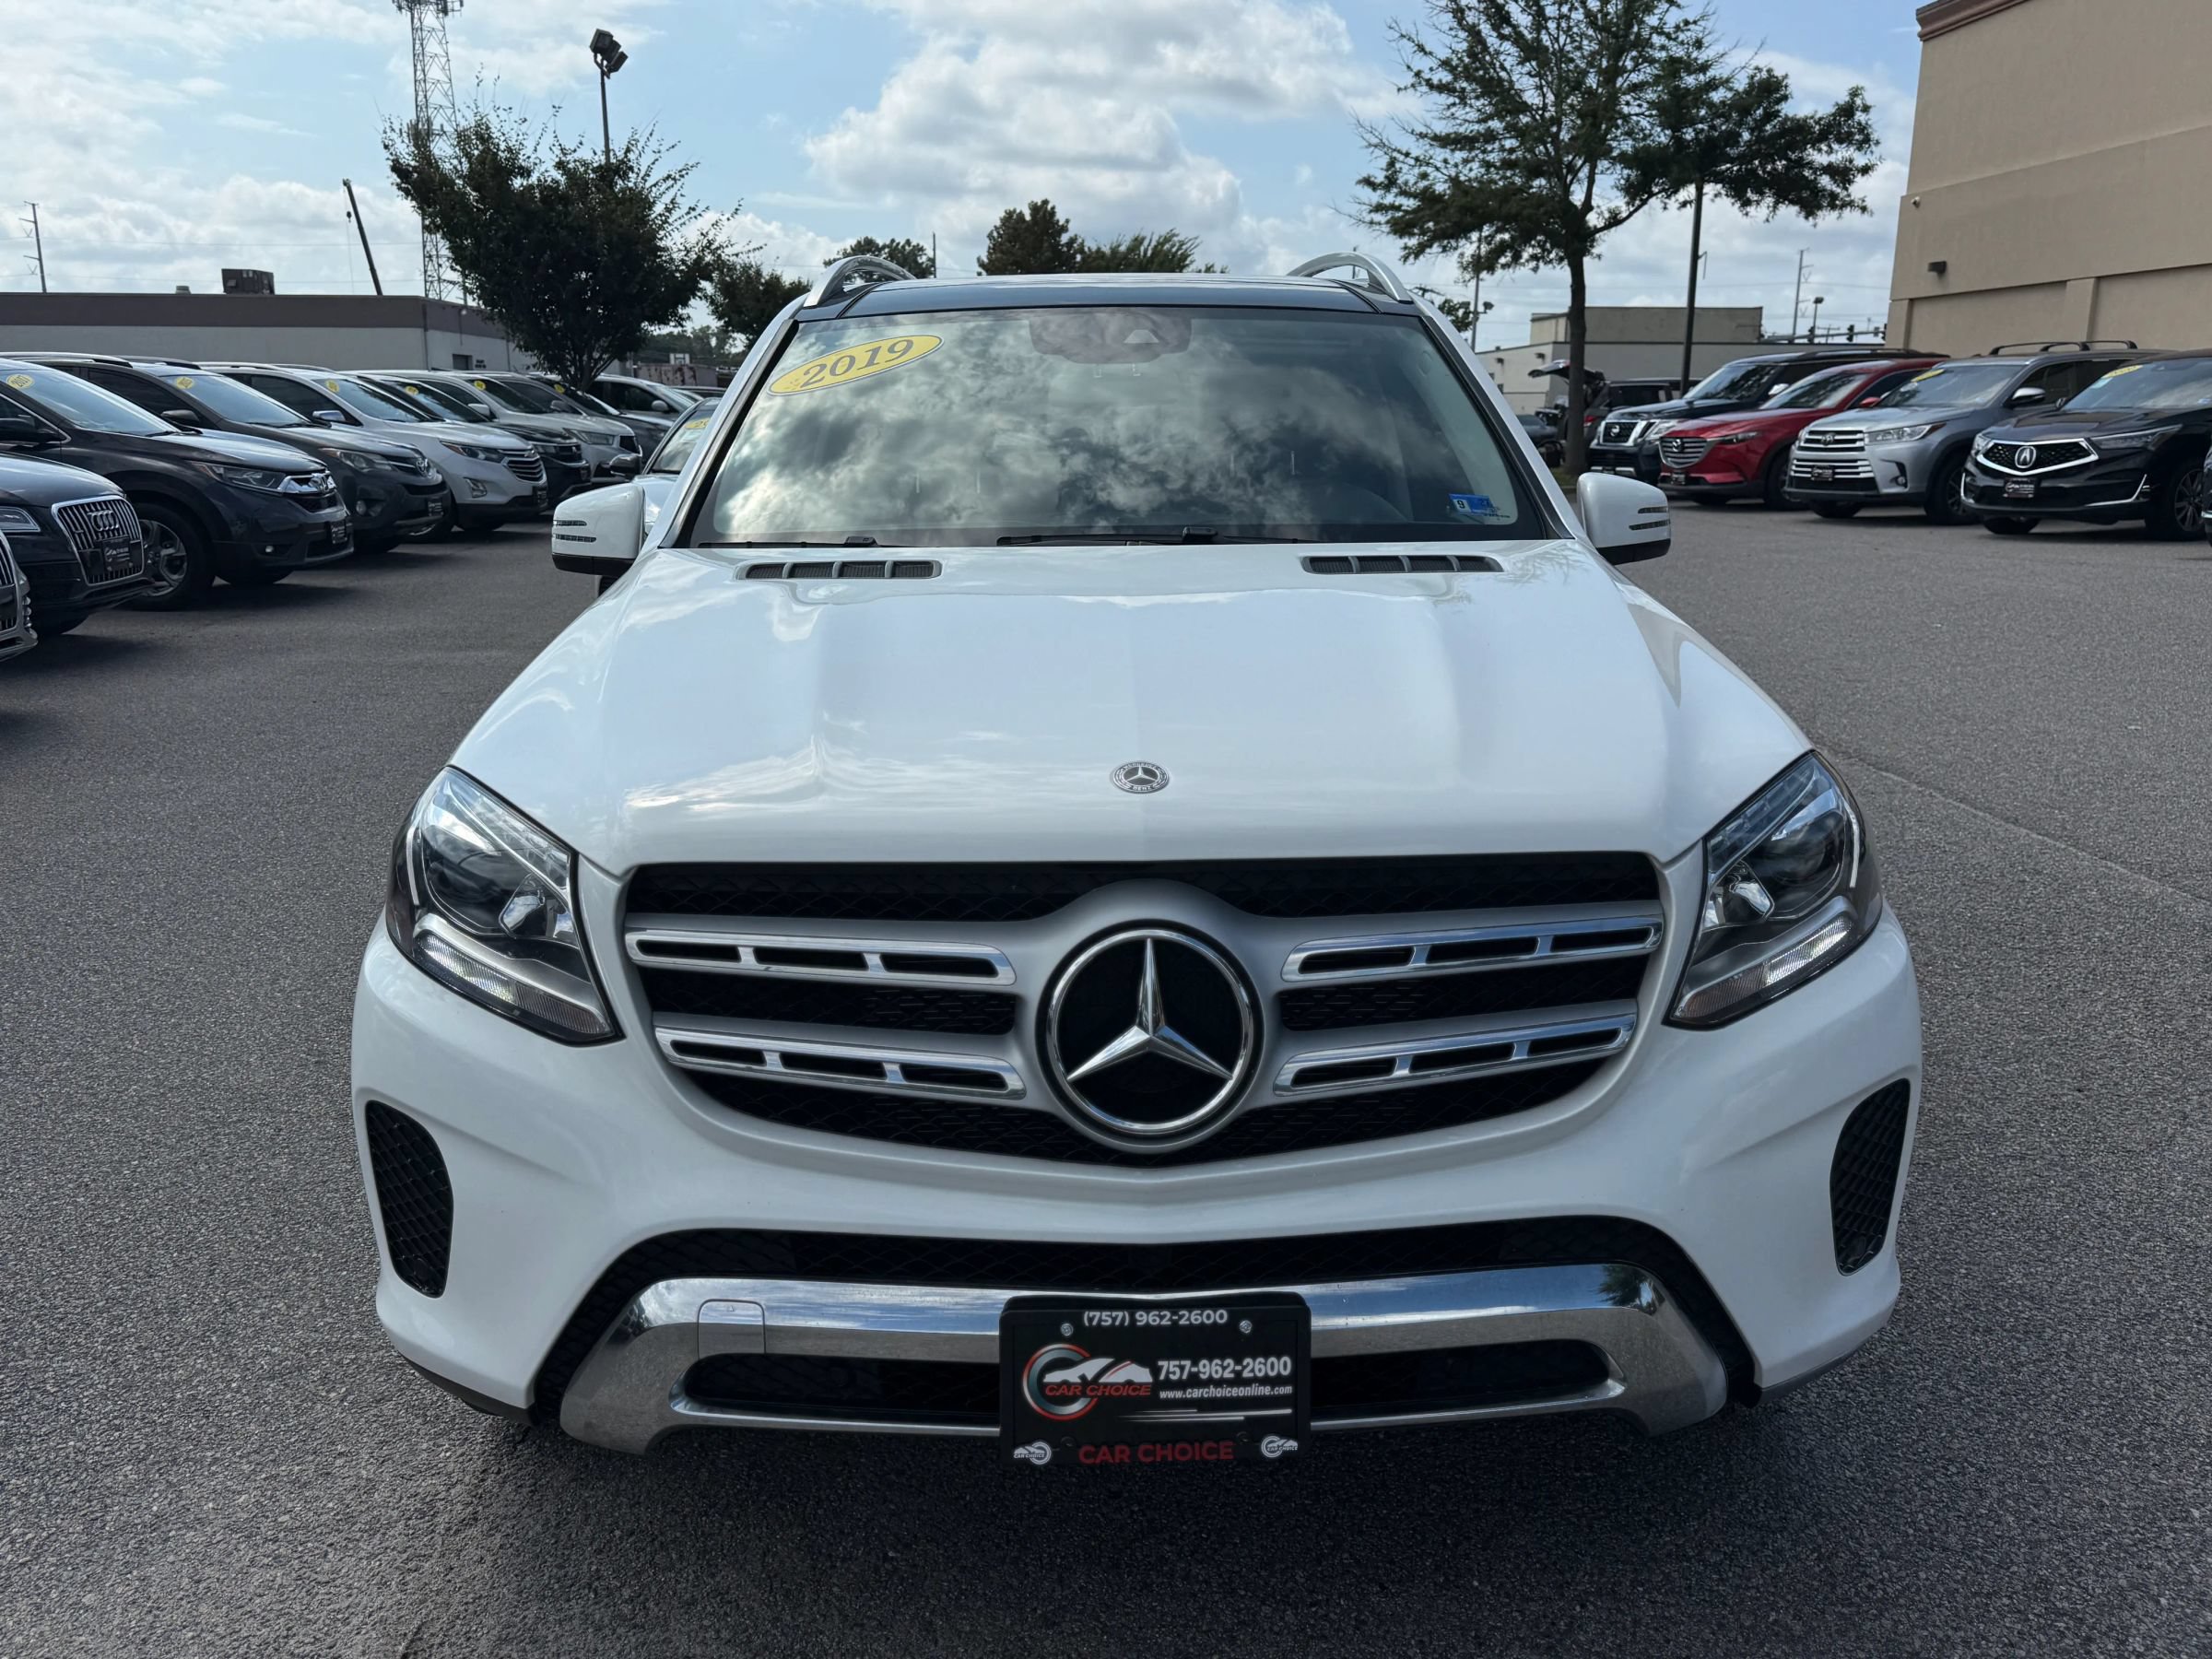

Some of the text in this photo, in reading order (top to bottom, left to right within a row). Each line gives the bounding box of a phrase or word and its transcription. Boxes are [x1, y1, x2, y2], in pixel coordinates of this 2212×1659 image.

[799, 338, 915, 388] 2019
[1457, 500, 1465, 509] 9
[1083, 1309, 1228, 1326] (757) 962-2600
[1158, 1356, 1292, 1381] 757-962-2600
[1044, 1384, 1152, 1396] CAR CHOICE
[1159, 1383, 1293, 1399] www.carchoiceonline.com
[1078, 1441, 1234, 1465] CAR CHOICE
